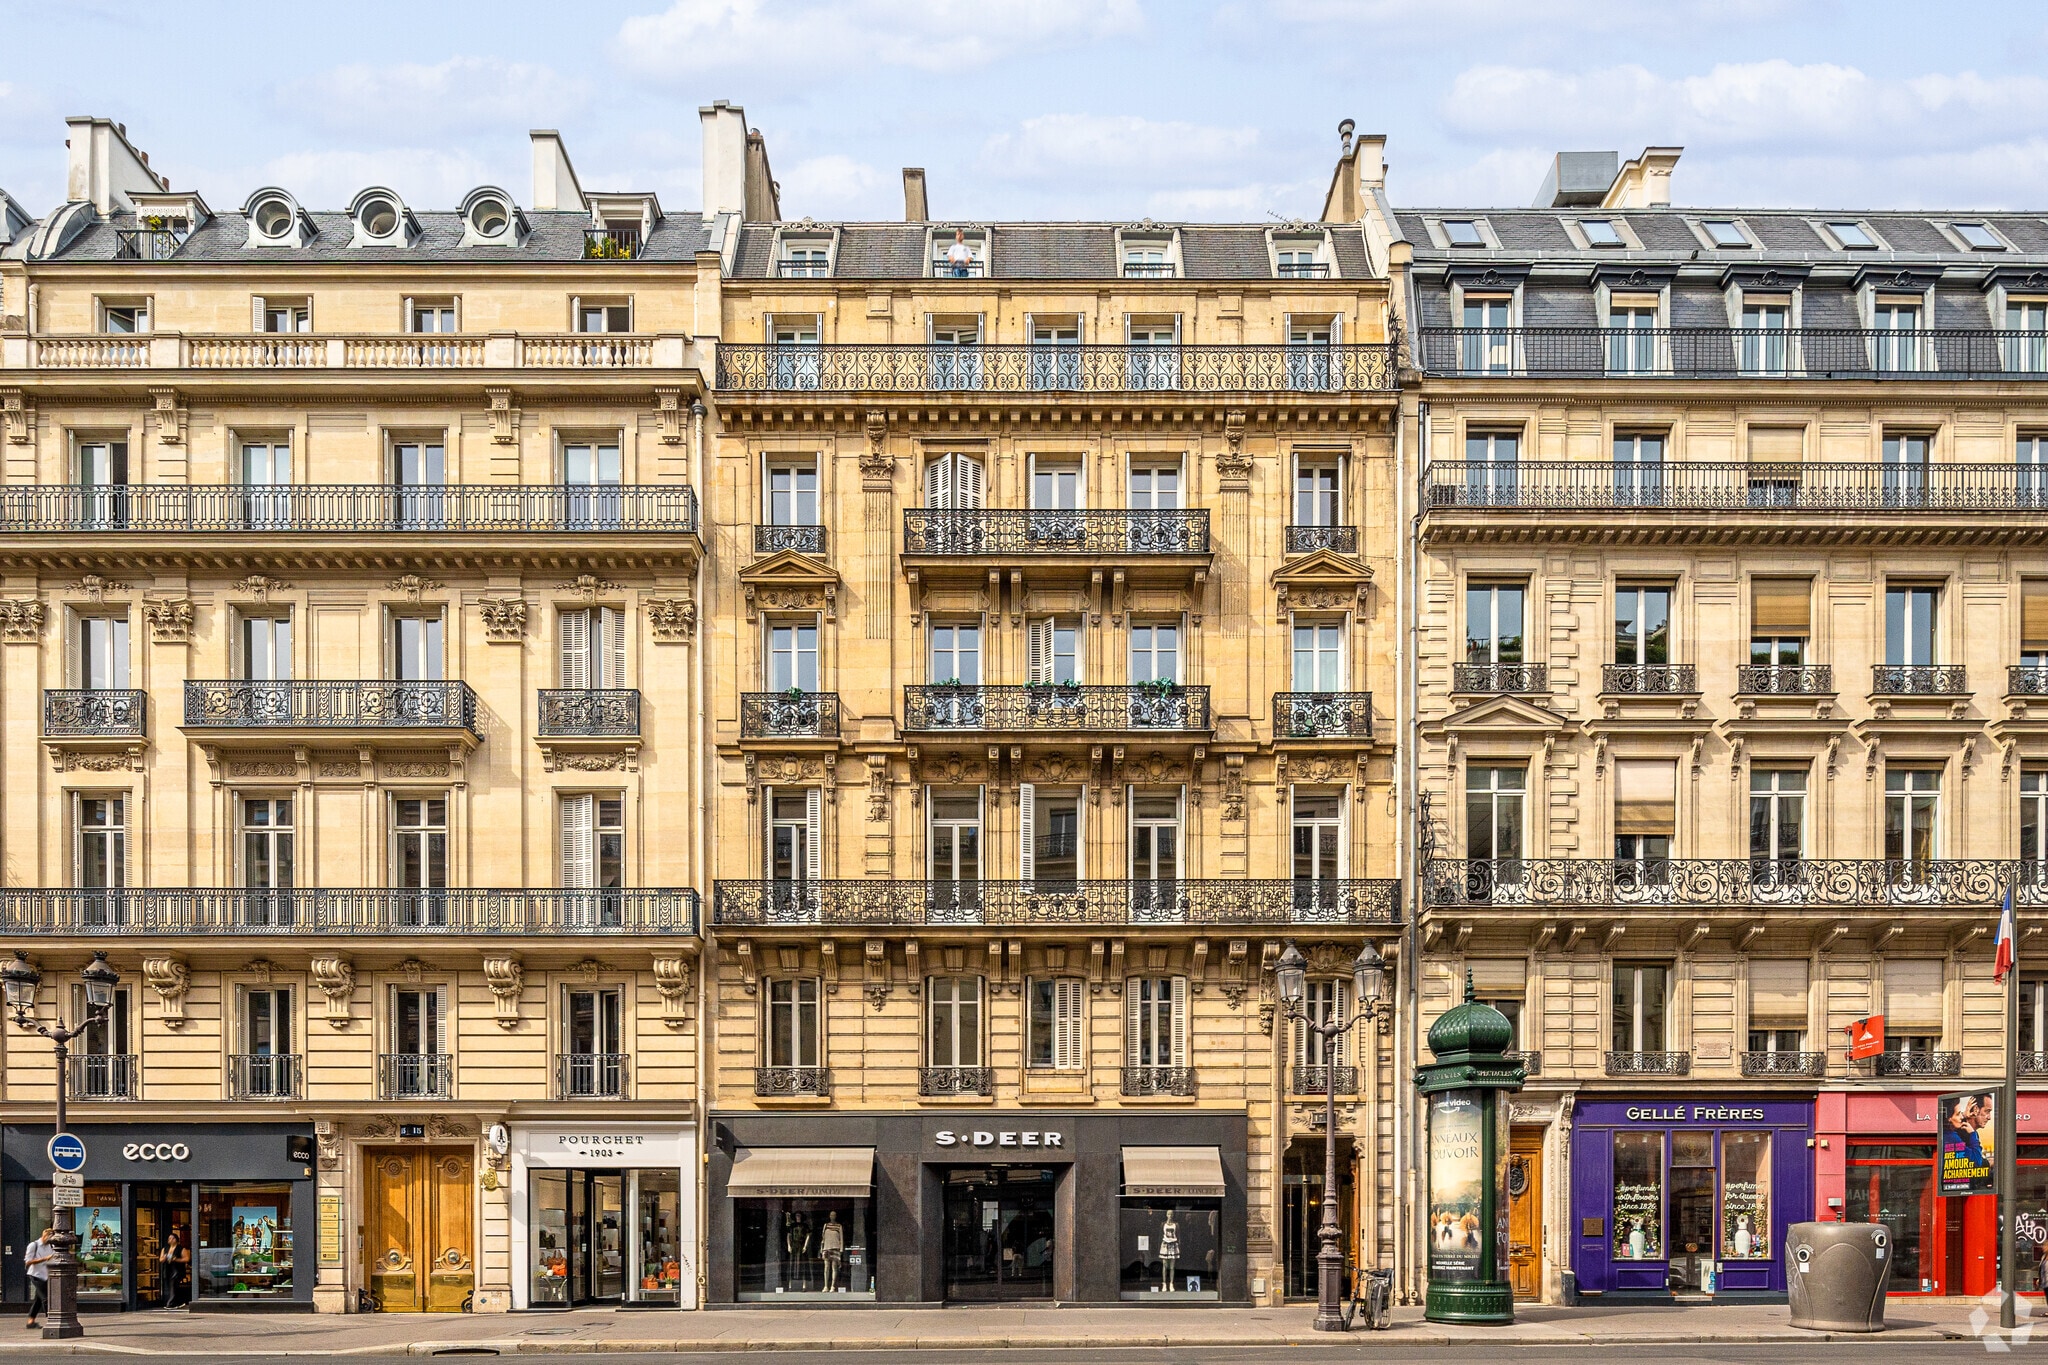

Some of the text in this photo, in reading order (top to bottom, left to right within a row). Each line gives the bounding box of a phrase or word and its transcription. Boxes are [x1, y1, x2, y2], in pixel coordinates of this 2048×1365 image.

[1449, 1098, 1471, 1107] video
[1626, 1105, 1764, 1120] GELLÉ FRÈRES
[1916, 1113, 1931, 1121] LA
[559, 1135, 644, 1145] POURCHET
[122, 1143, 190, 1161] ecco
[293, 1150, 310, 1159] ecco
[590, 1149, 613, 1157] 1903
[1432, 1146, 1479, 1160] OUVOIR
[1944, 1151, 1955, 1159] AVEC
[1944, 1158, 1969, 1170] AMOUR
[1943, 1167, 1989, 1179] ACHARNEMENT
